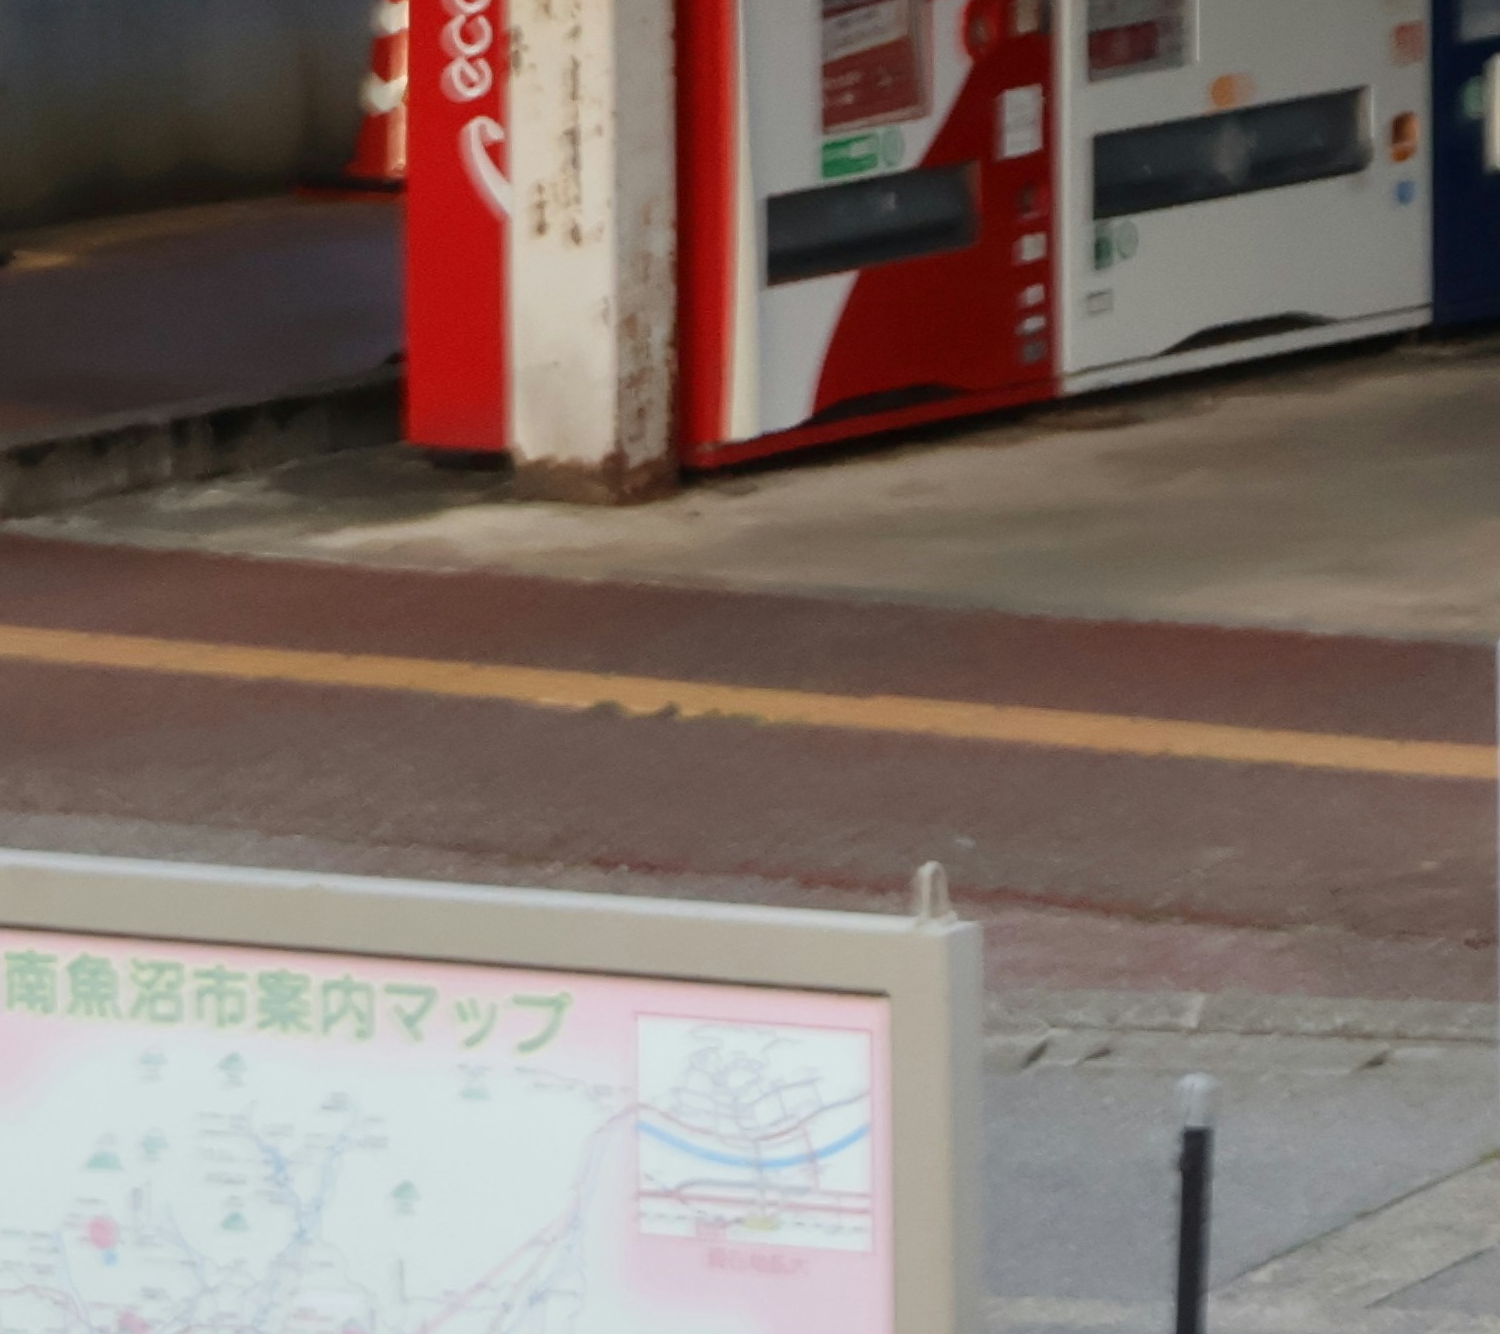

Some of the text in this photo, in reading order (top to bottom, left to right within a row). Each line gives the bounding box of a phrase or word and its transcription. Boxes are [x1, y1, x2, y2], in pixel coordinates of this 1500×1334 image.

[2, 947, 574, 1055] 南魚沼市案内マップ
